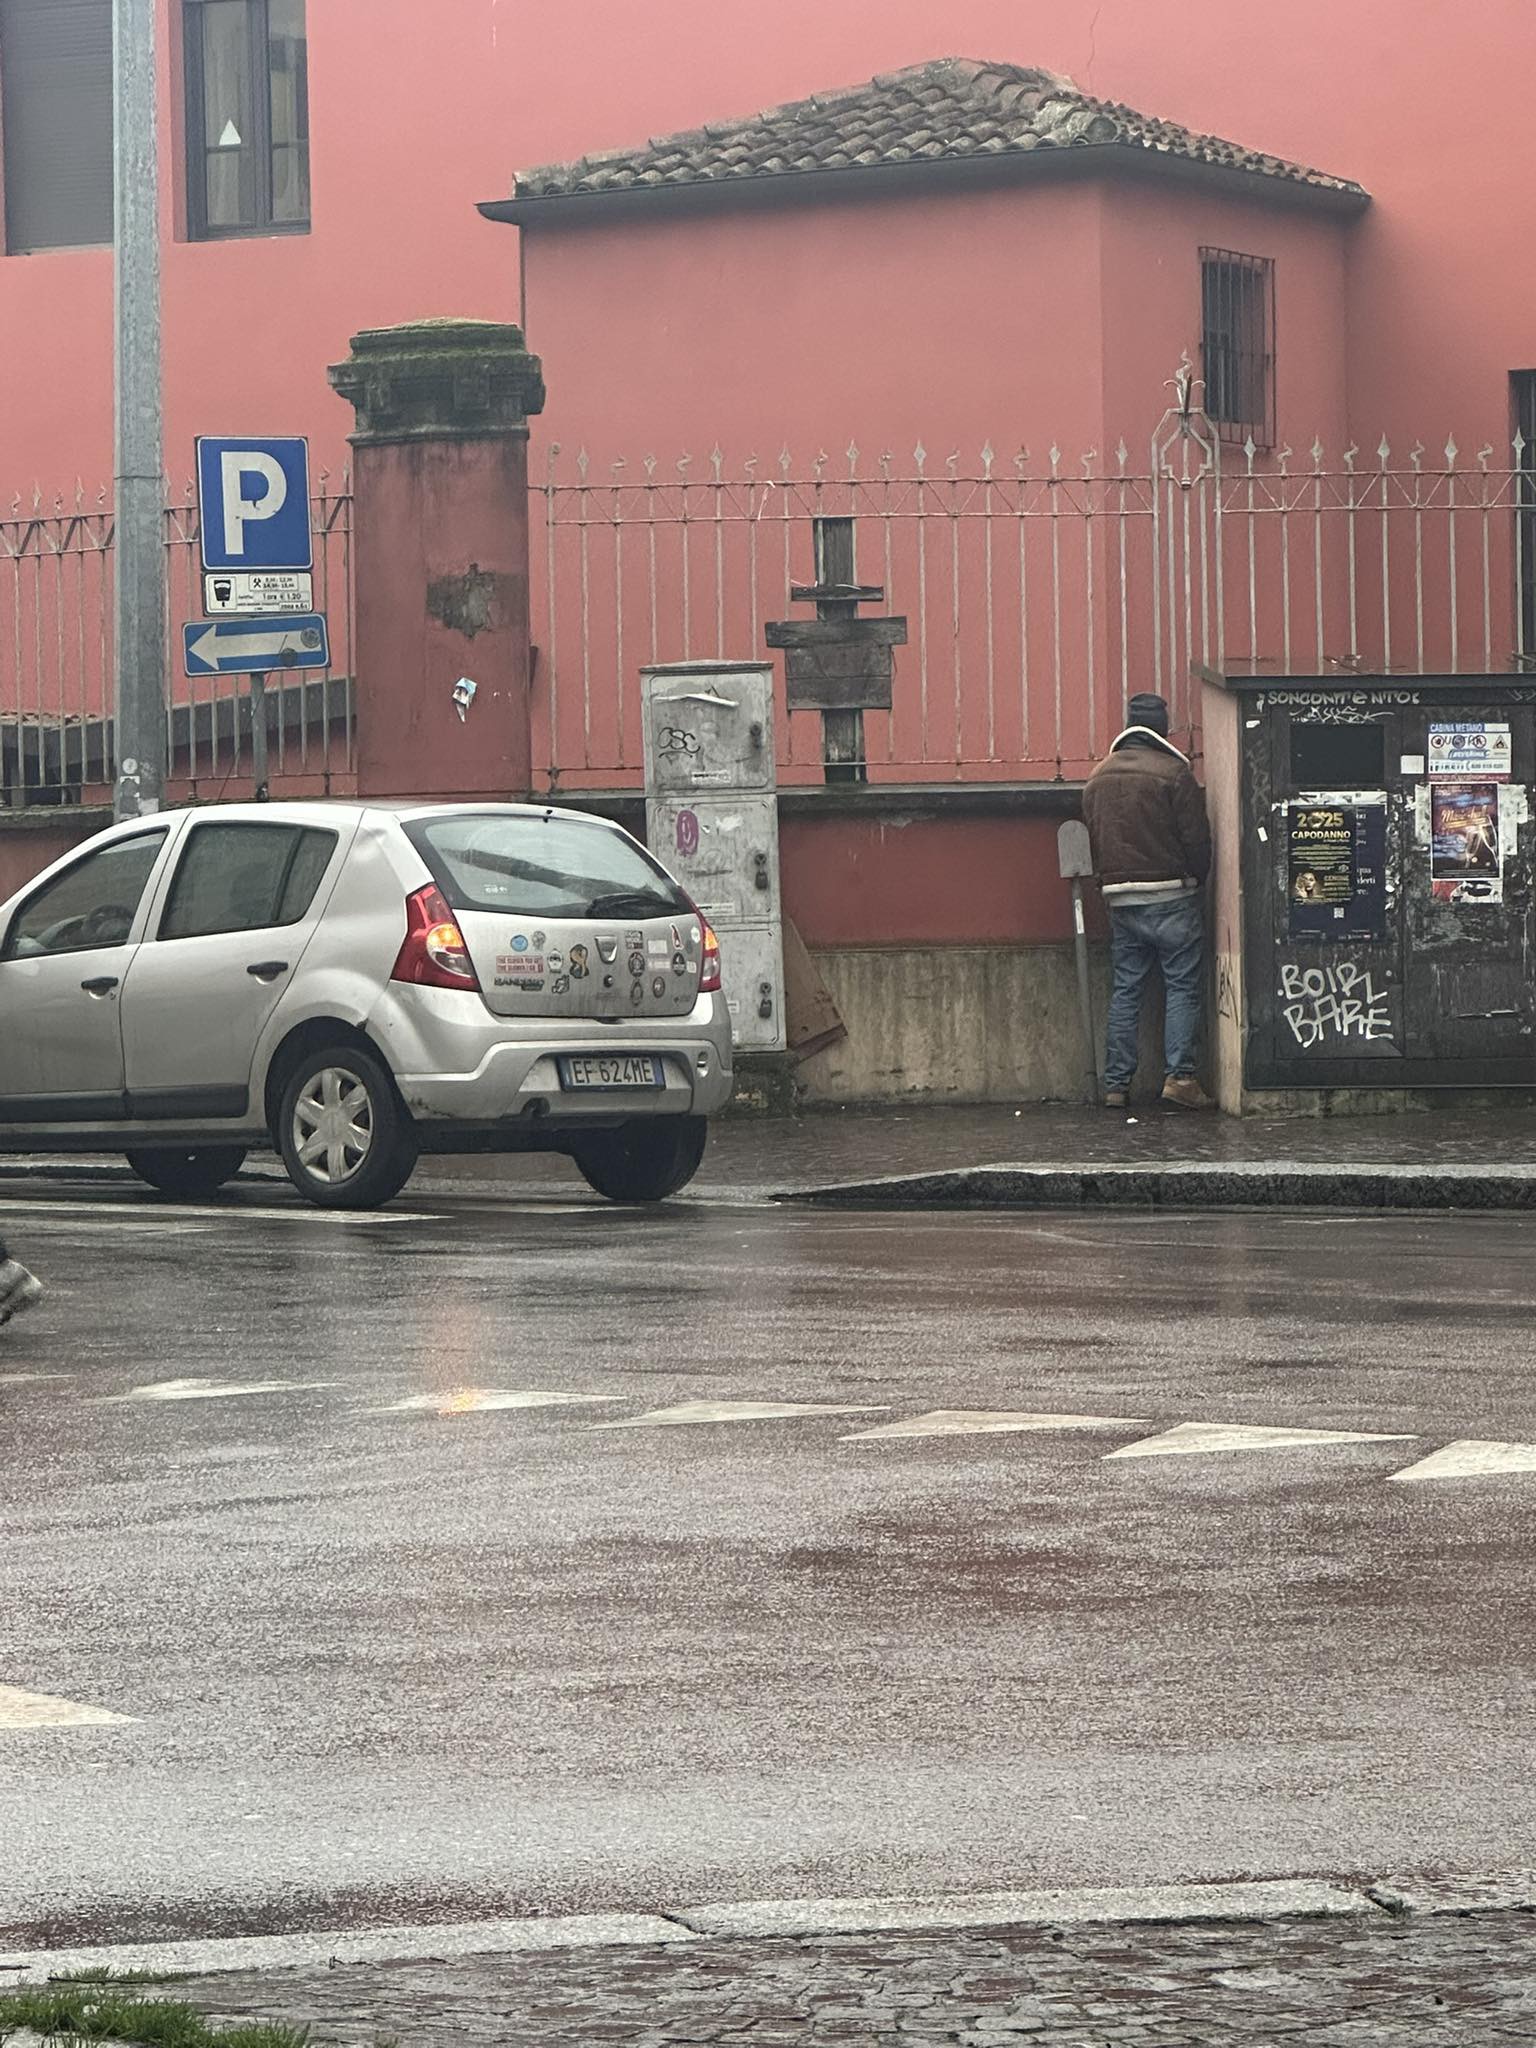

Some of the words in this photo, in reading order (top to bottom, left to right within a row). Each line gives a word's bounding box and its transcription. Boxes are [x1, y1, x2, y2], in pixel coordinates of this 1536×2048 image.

[220, 451, 287, 555] P
[1430, 723, 1455, 733] CABINA
[1456, 723, 1483, 733] METANO
[1291, 830, 1352, 840] CAPODANNO
[1282, 994, 1394, 1048] BARE
